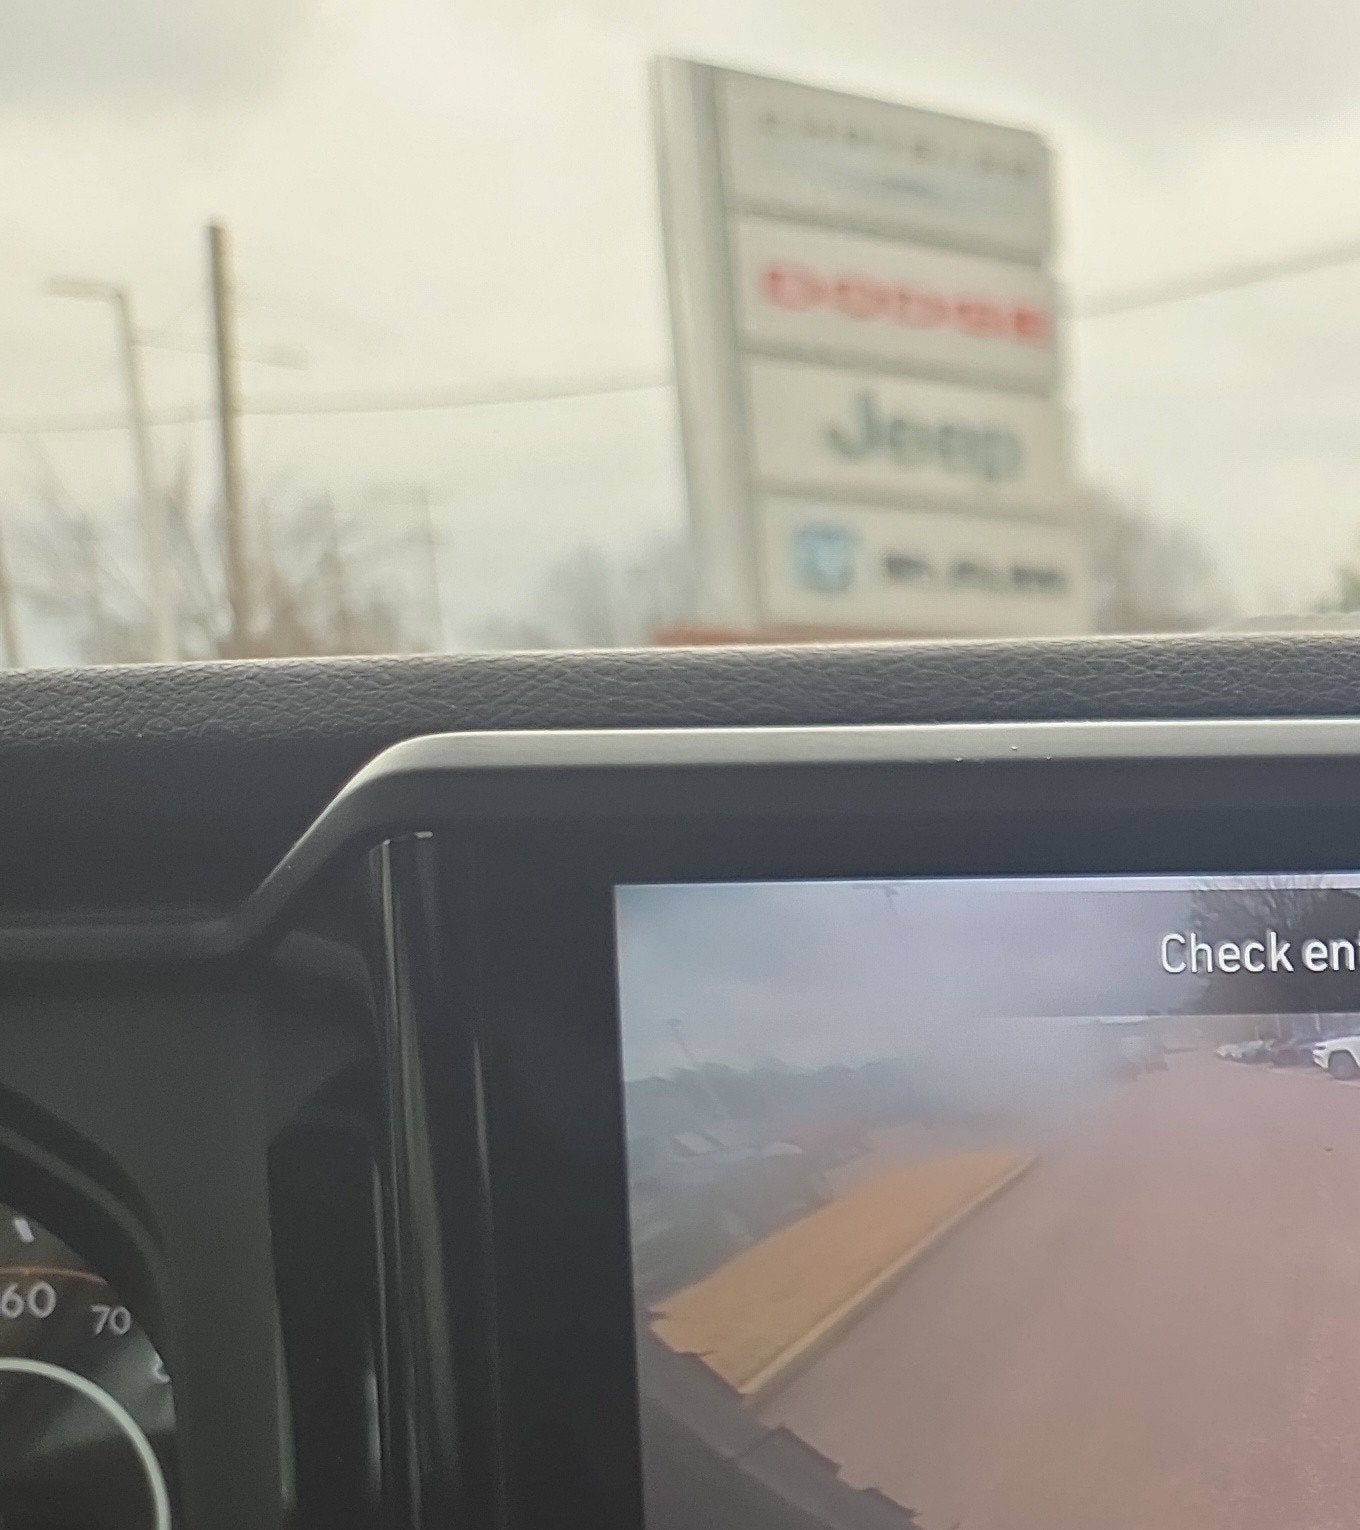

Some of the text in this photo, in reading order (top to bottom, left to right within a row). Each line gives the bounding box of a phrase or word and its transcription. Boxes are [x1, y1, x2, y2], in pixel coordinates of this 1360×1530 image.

[1160, 931, 1295, 974] Check
[0, 1279, 57, 1319] 60
[89, 1304, 132, 1335] 70
